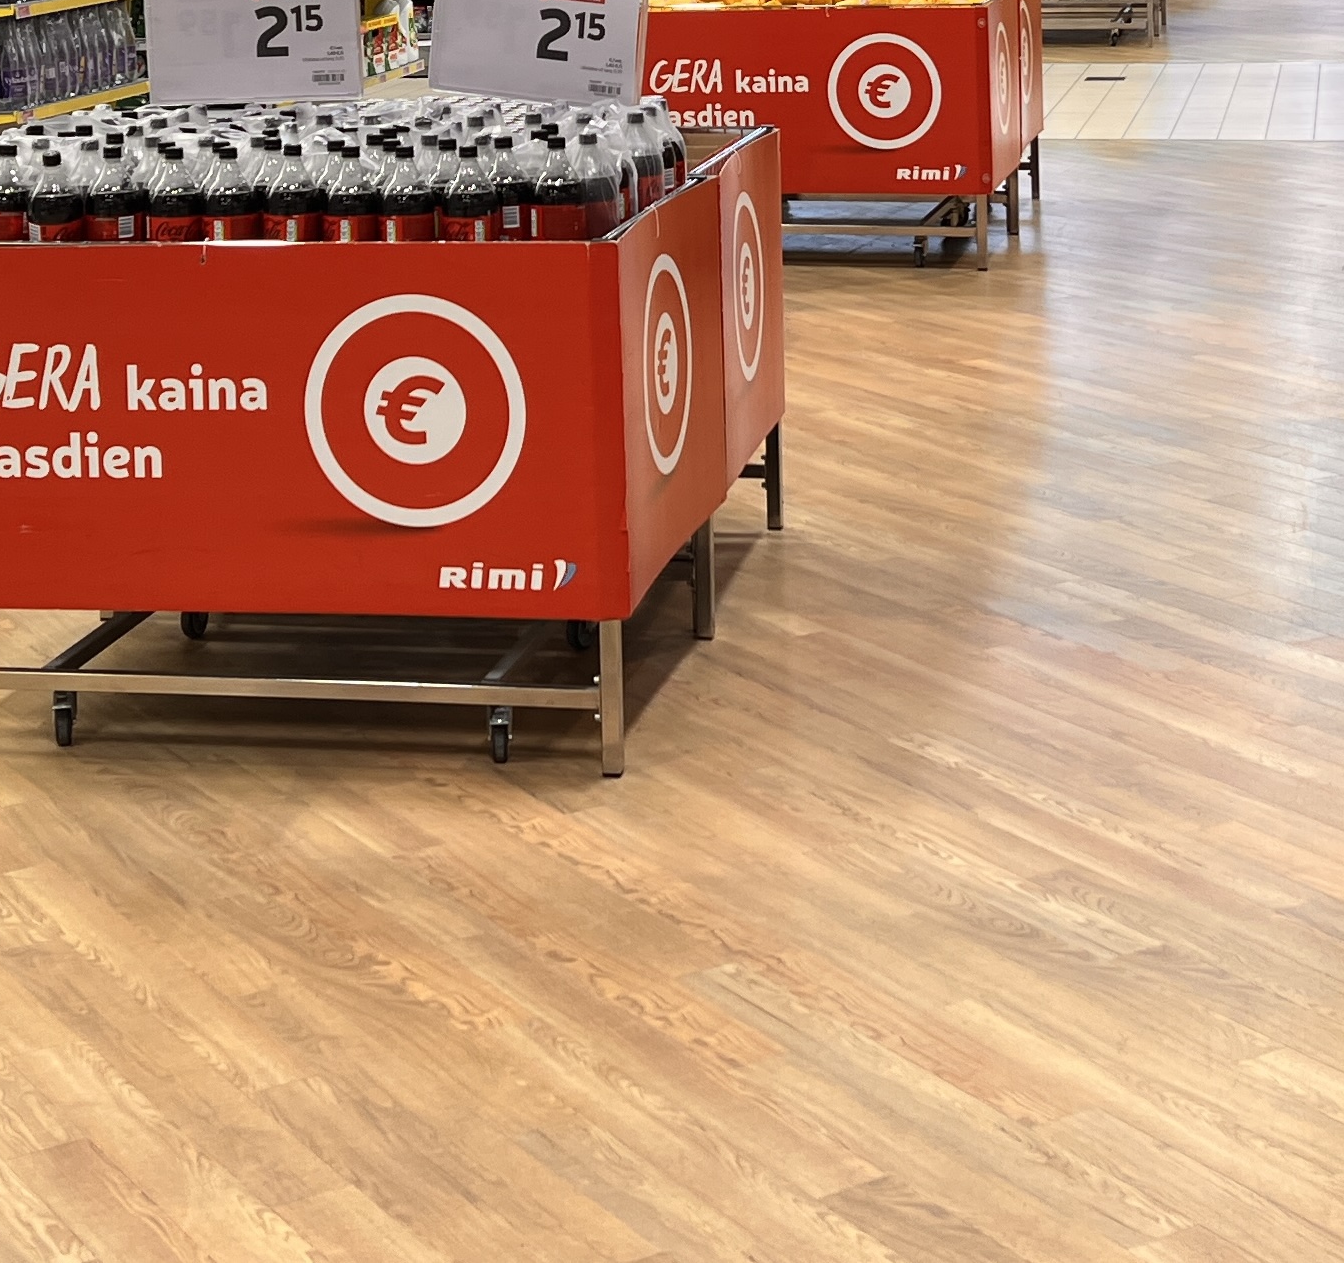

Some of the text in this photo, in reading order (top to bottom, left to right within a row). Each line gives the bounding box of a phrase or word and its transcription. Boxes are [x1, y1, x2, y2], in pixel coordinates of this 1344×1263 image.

[254, 4, 324, 58] 215
[536, 8, 606, 62] 215
[650, 59, 723, 95] GERA
[735, 69, 809, 93] kaina
[670, 103, 755, 127] asdien
[896, 166, 950, 181] Rimi
[126, 363, 267, 412] kaina
[438, 561, 545, 592] Rimi
